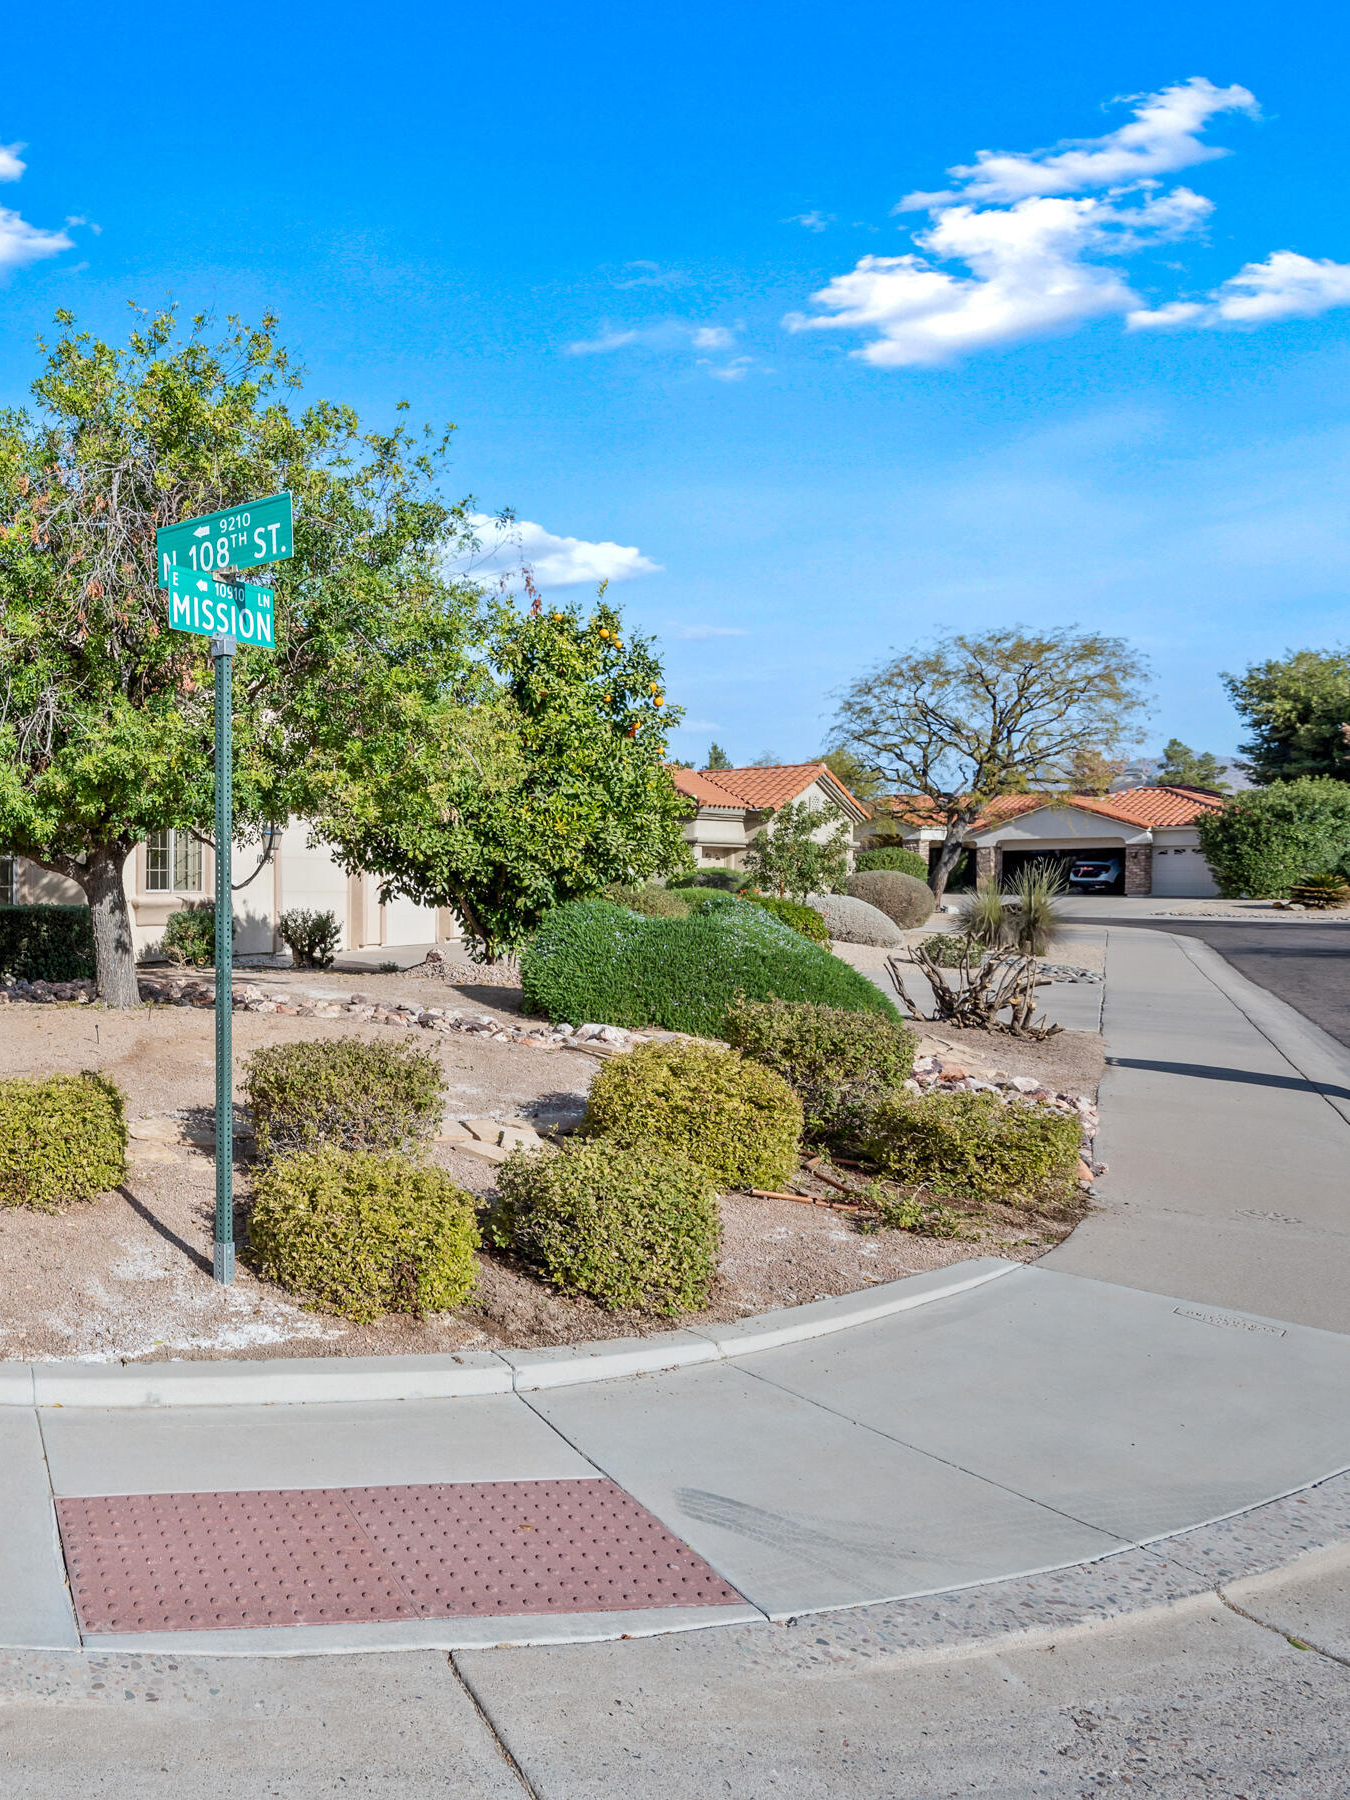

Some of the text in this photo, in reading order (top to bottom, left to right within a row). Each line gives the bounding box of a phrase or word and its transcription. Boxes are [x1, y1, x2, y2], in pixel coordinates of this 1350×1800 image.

[219, 512, 251, 533] 9210
[163, 522, 287, 581] N 108TH ST.
[172, 572, 270, 608] E 10910 LN
[172, 591, 272, 642] MISSION
